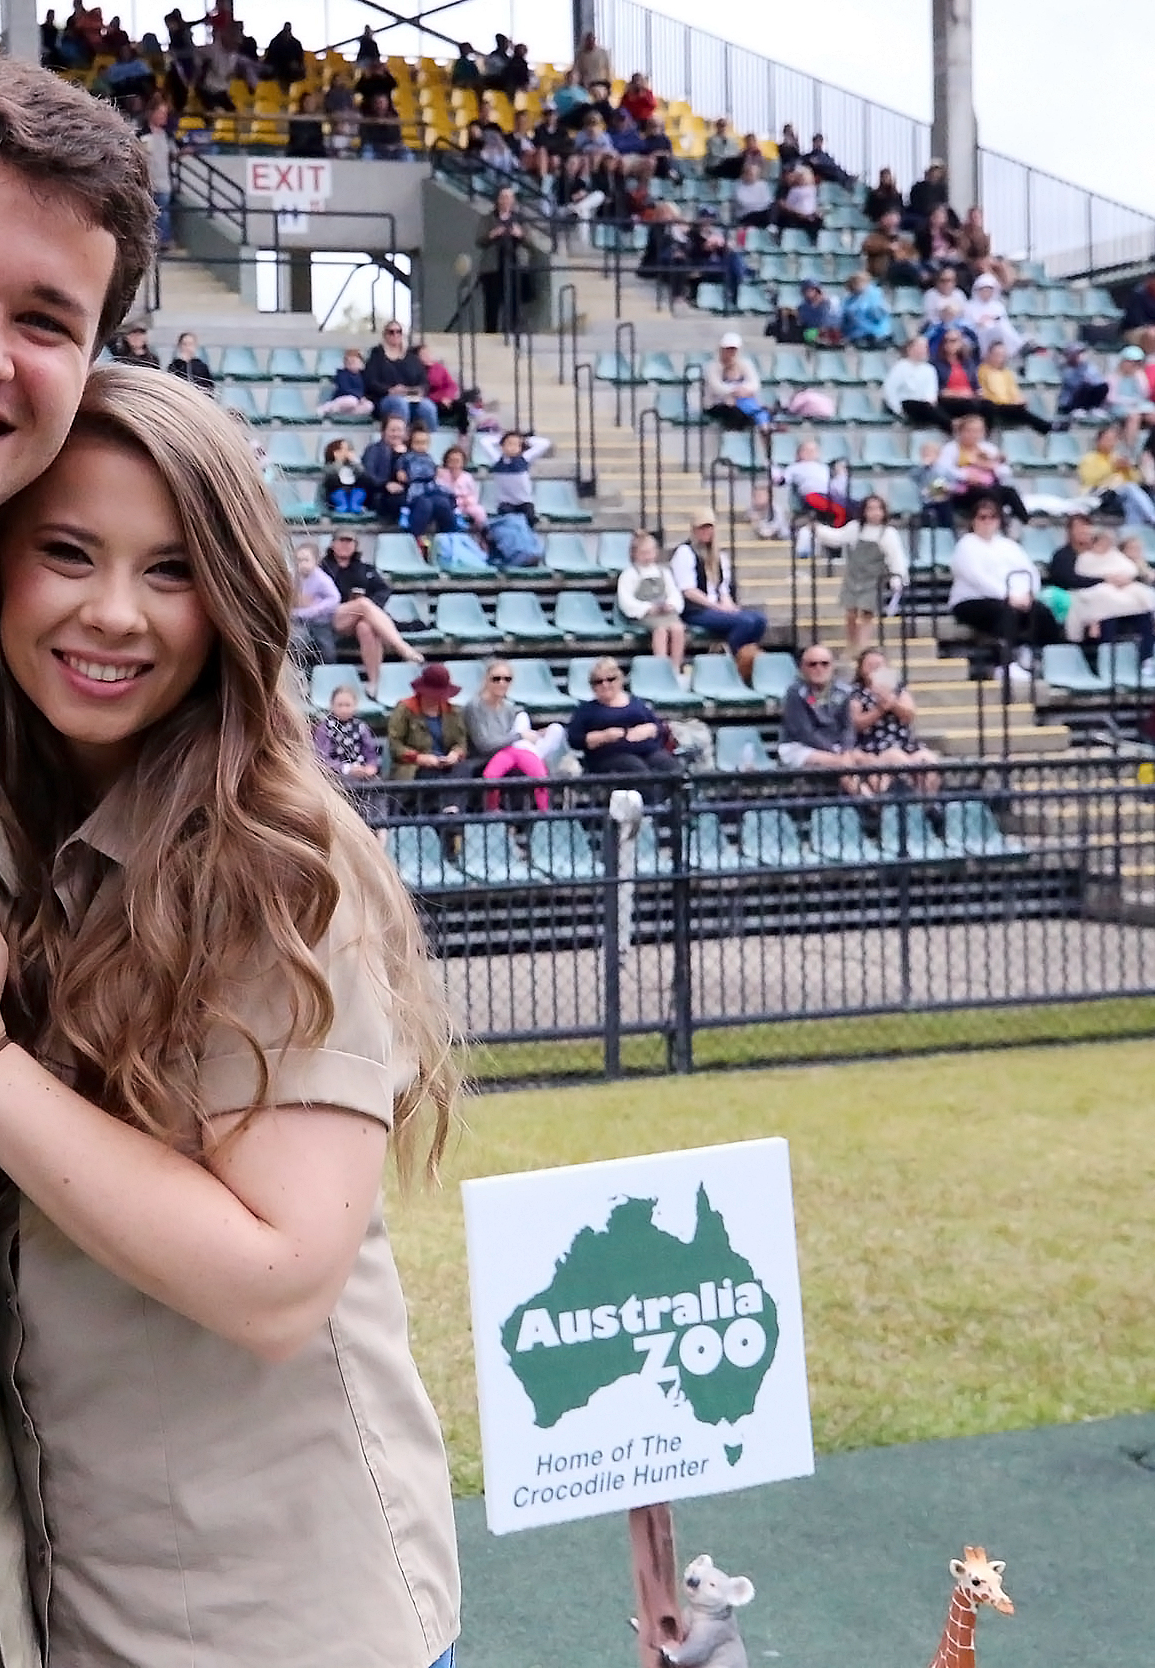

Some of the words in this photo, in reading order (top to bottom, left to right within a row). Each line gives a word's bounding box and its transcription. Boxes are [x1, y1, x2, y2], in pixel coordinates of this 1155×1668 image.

[252, 163, 326, 192] EXIT
[515, 1277, 764, 1353] Australia
[537, 1449, 603, 1476] Home
[610, 1438, 634, 1462] of
[641, 1434, 682, 1457] The
[513, 1471, 625, 1508] Crocodile
[633, 1458, 709, 1487] Hunter
